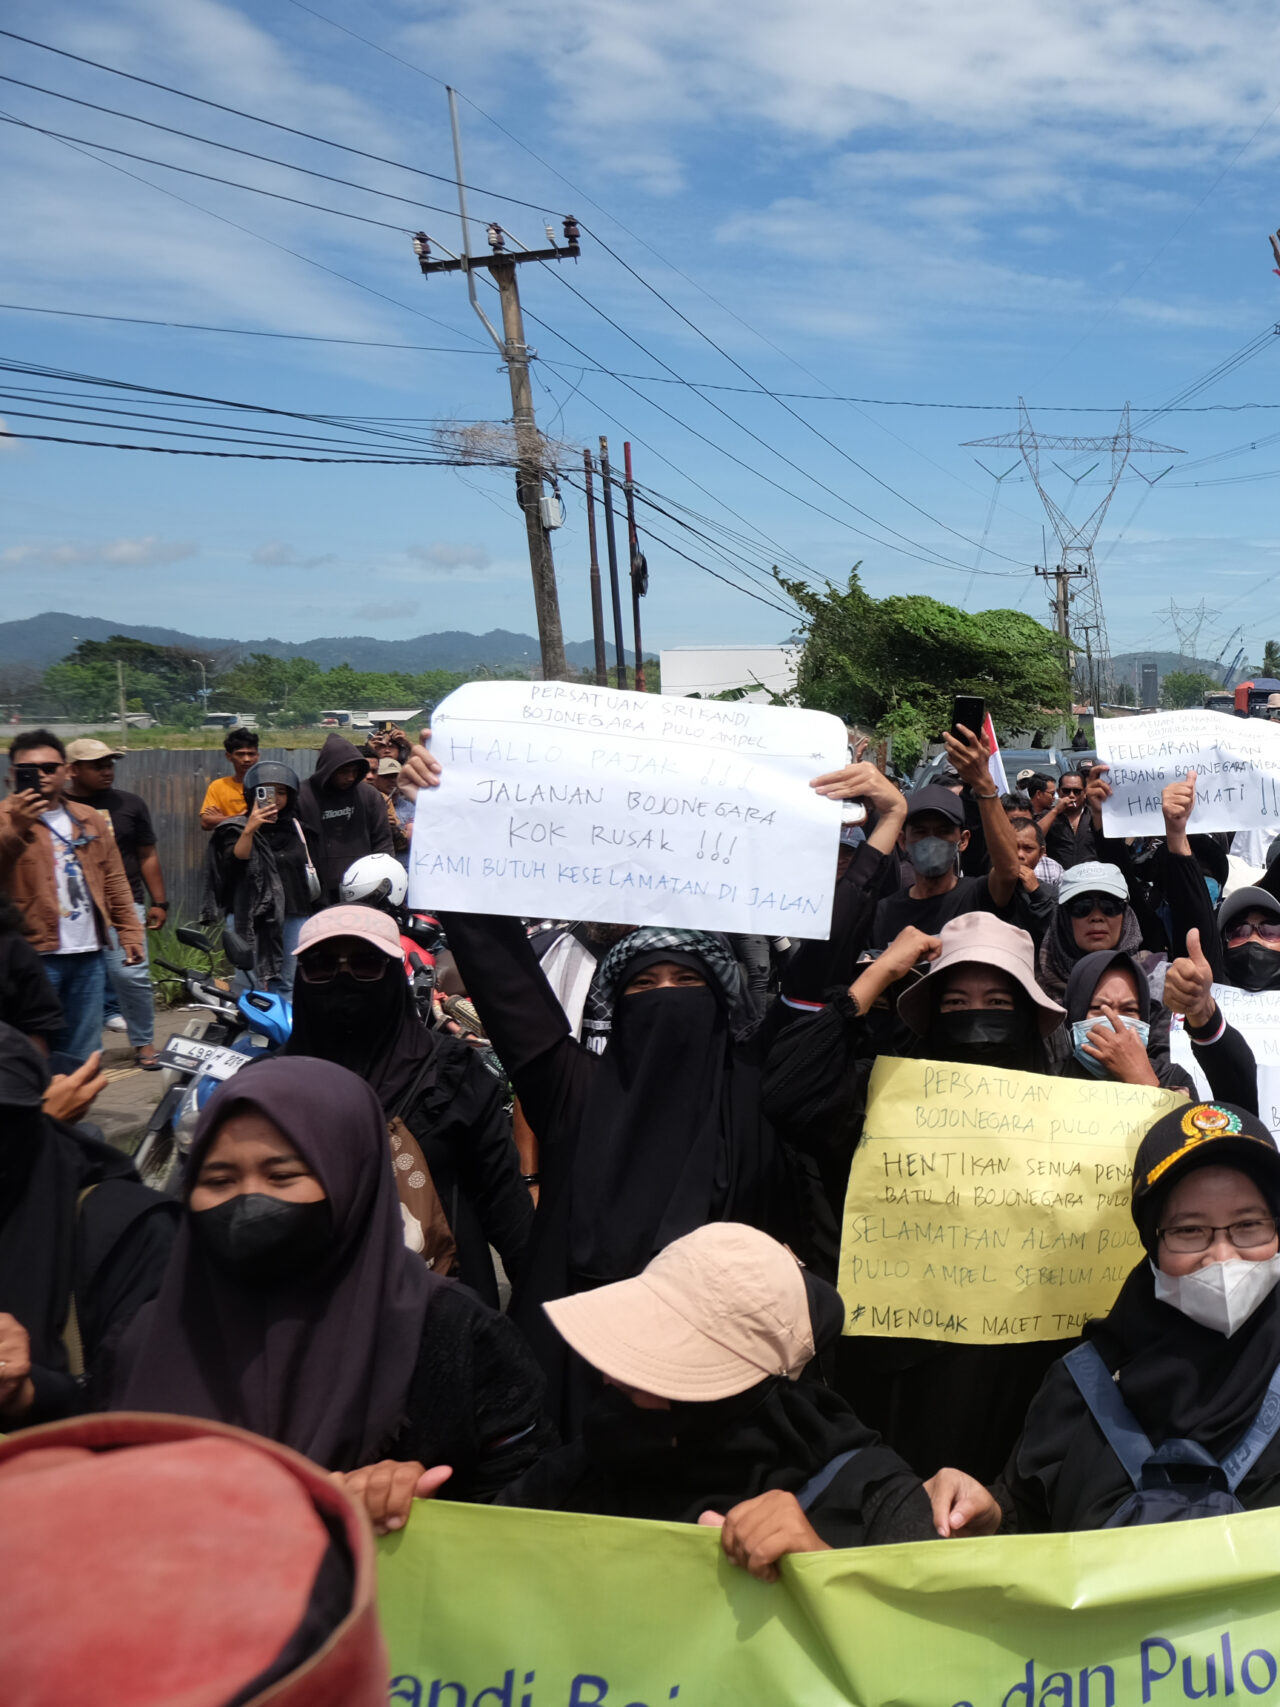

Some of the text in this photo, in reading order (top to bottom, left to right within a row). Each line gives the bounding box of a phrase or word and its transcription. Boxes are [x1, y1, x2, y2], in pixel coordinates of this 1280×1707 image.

[531, 685, 751, 727] PERSATUAN SRIKANDI
[522, 704, 769, 749] BOJONEGARA PULO AMPEL
[450, 736, 562, 764] HALLO
[592, 748, 681, 777] PAJAK
[469, 779, 778, 827] JALANAN BOJONEGARA
[1127, 793, 1163, 817] HAR
[508, 816, 567, 848] KOK
[696, 829, 739, 865] !!!
[413, 850, 825, 916] KAMI BUTUH KESELAMATAN DI JALAN
[923, 1066, 1054, 1104] PERSATUAN
[915, 1105, 1154, 1139] BOJONEGARA PULO AMP
[882, 1152, 1011, 1179] HENTIKAN
[1026, 1157, 1083, 1177] SEMUA
[884, 1185, 934, 1207] BATU
[973, 1185, 1085, 1210] BOJONEGARA
[1096, 1192, 1131, 1212] PULO
[851, 1213, 1011, 1251] SELAMATKAN
[1020, 1227, 1087, 1251] ALAM
[851, 1254, 910, 1285] PULO
[922, 1263, 998, 1288] AMPEL
[1014, 1264, 1093, 1290] SEBELUM
[982, 1314, 1043, 1336] MACET
